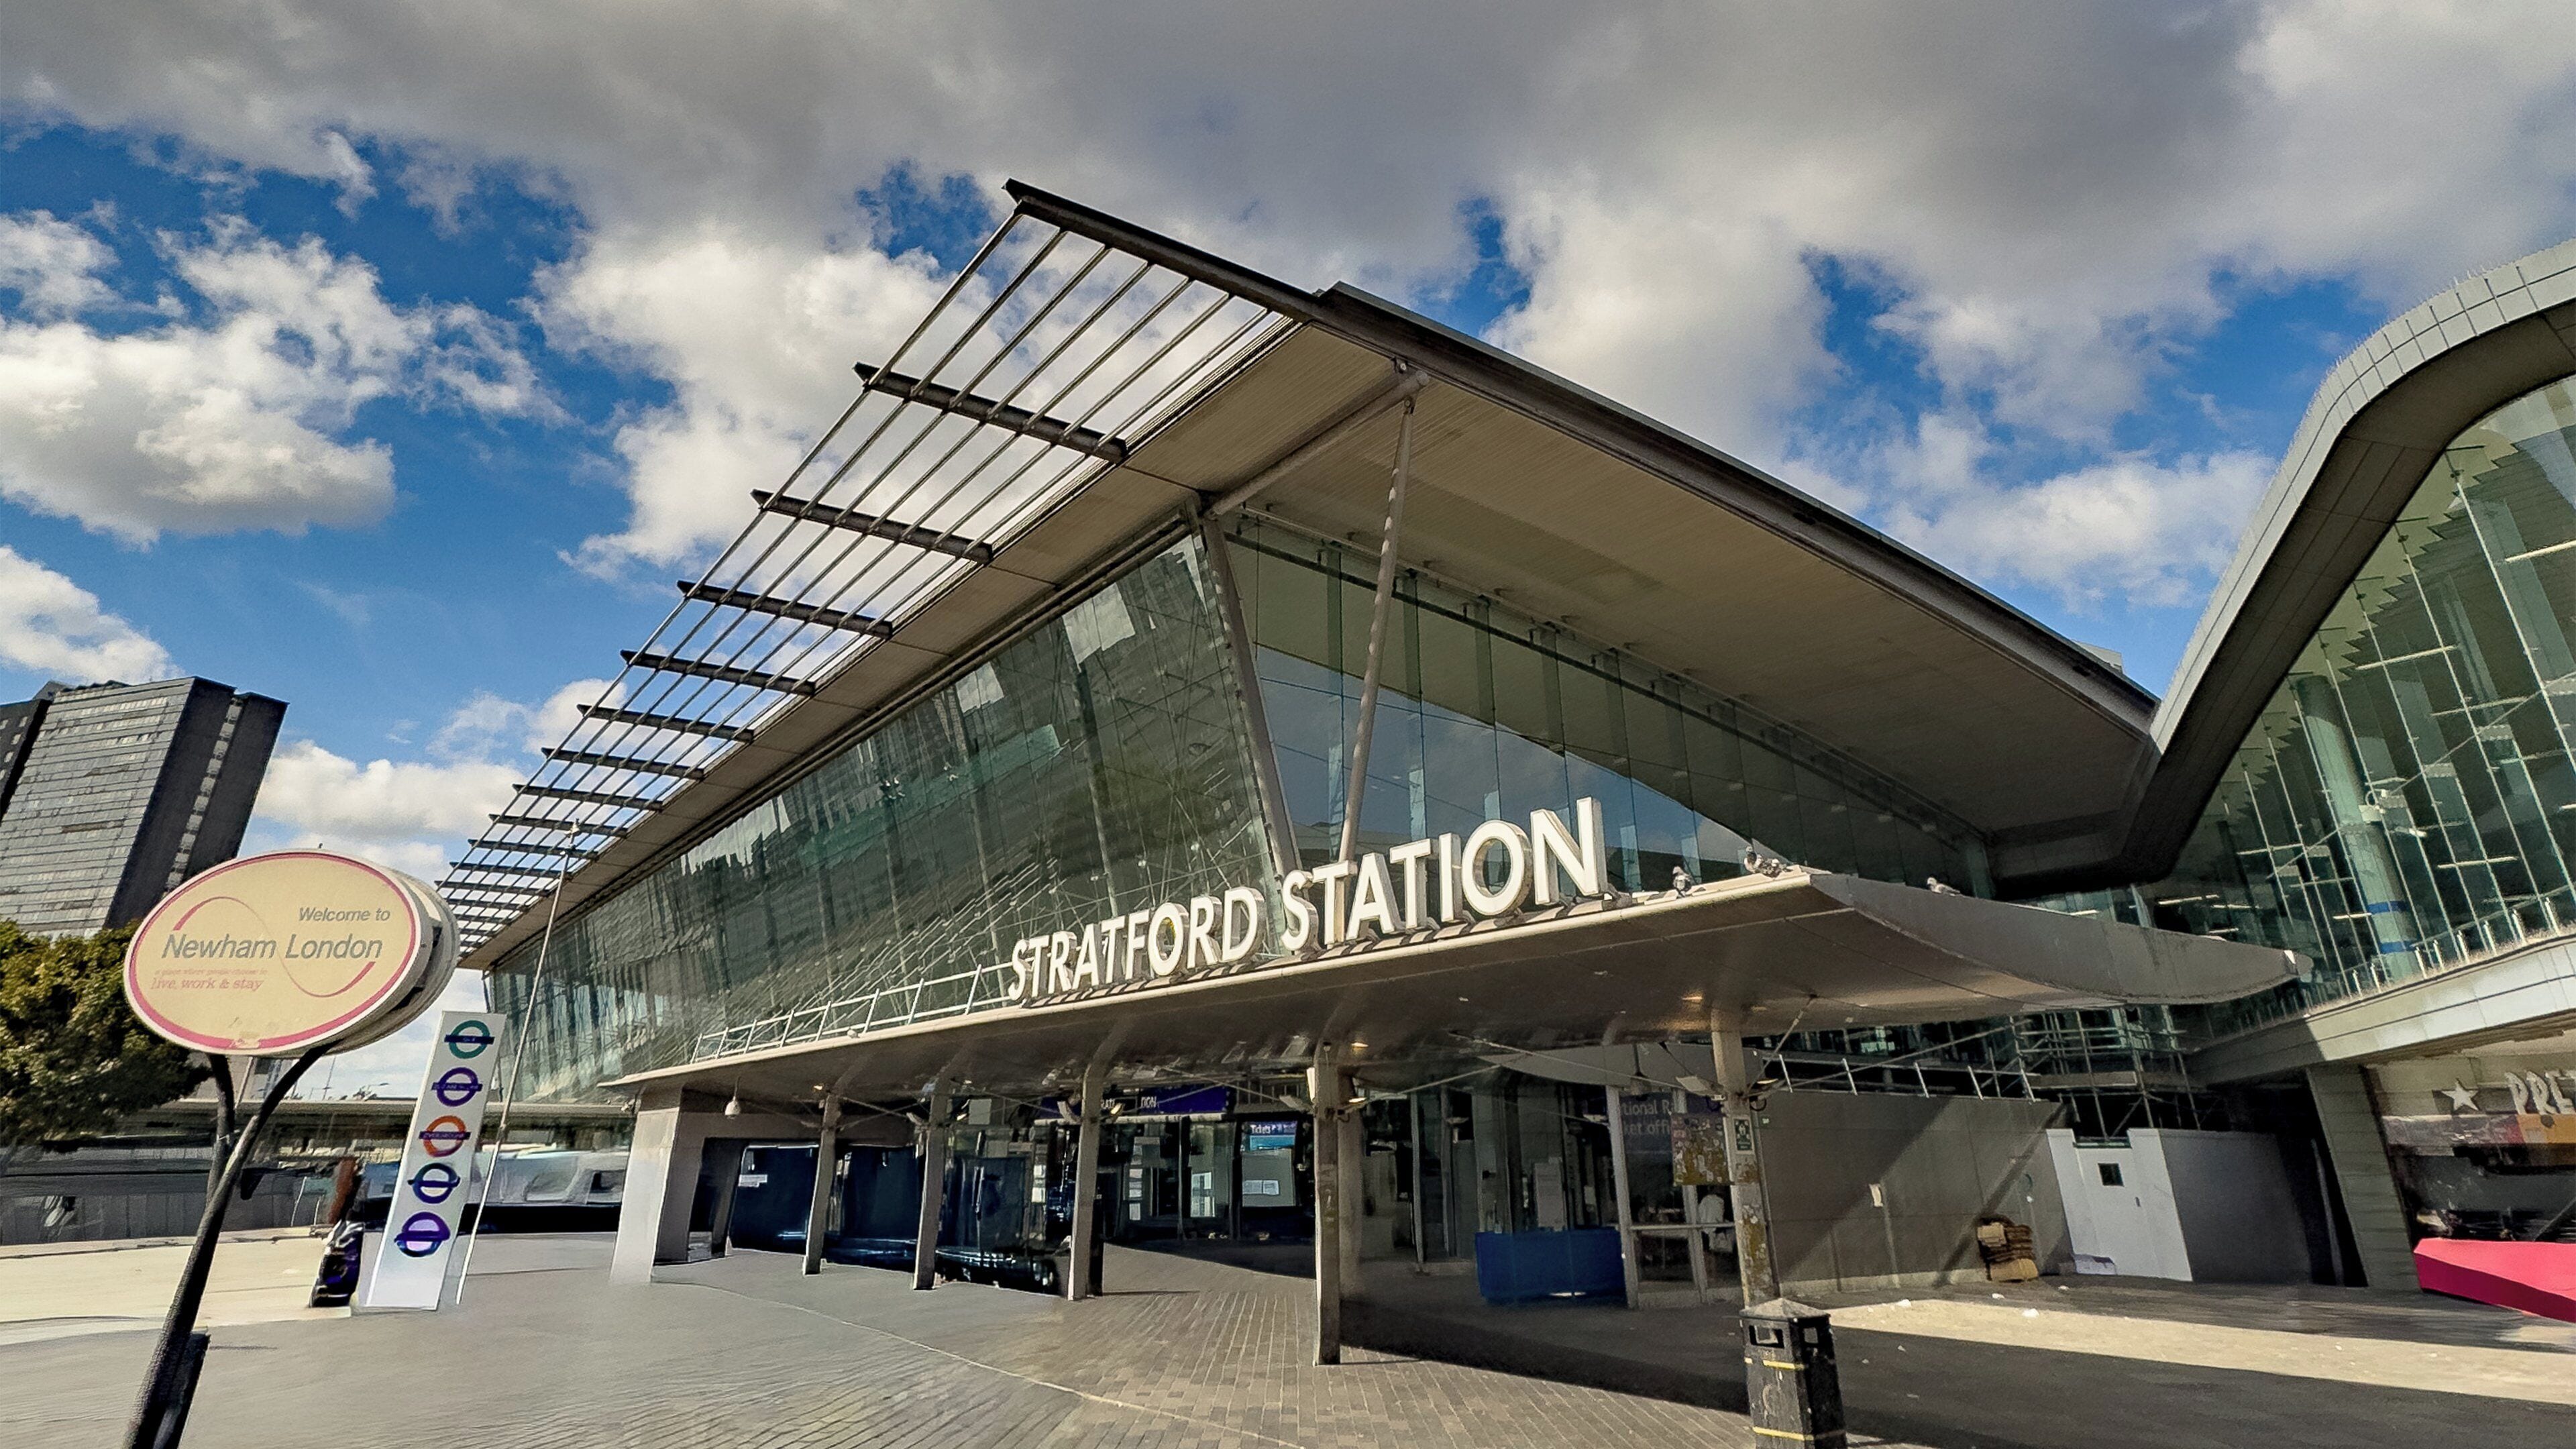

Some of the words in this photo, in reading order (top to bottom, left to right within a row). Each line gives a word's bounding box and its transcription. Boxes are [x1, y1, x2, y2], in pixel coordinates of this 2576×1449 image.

[1008, 886, 1265, 1002] STRATFORD
[1281, 796, 1606, 951] STATION
[299, 907, 370, 922] Welcome
[375, 907, 390, 921] to
[162, 933, 277, 959] Newham
[285, 933, 382, 959] London
[181, 977, 217, 989] work
[219, 978, 229, 989] &
[233, 977, 265, 992] stay
